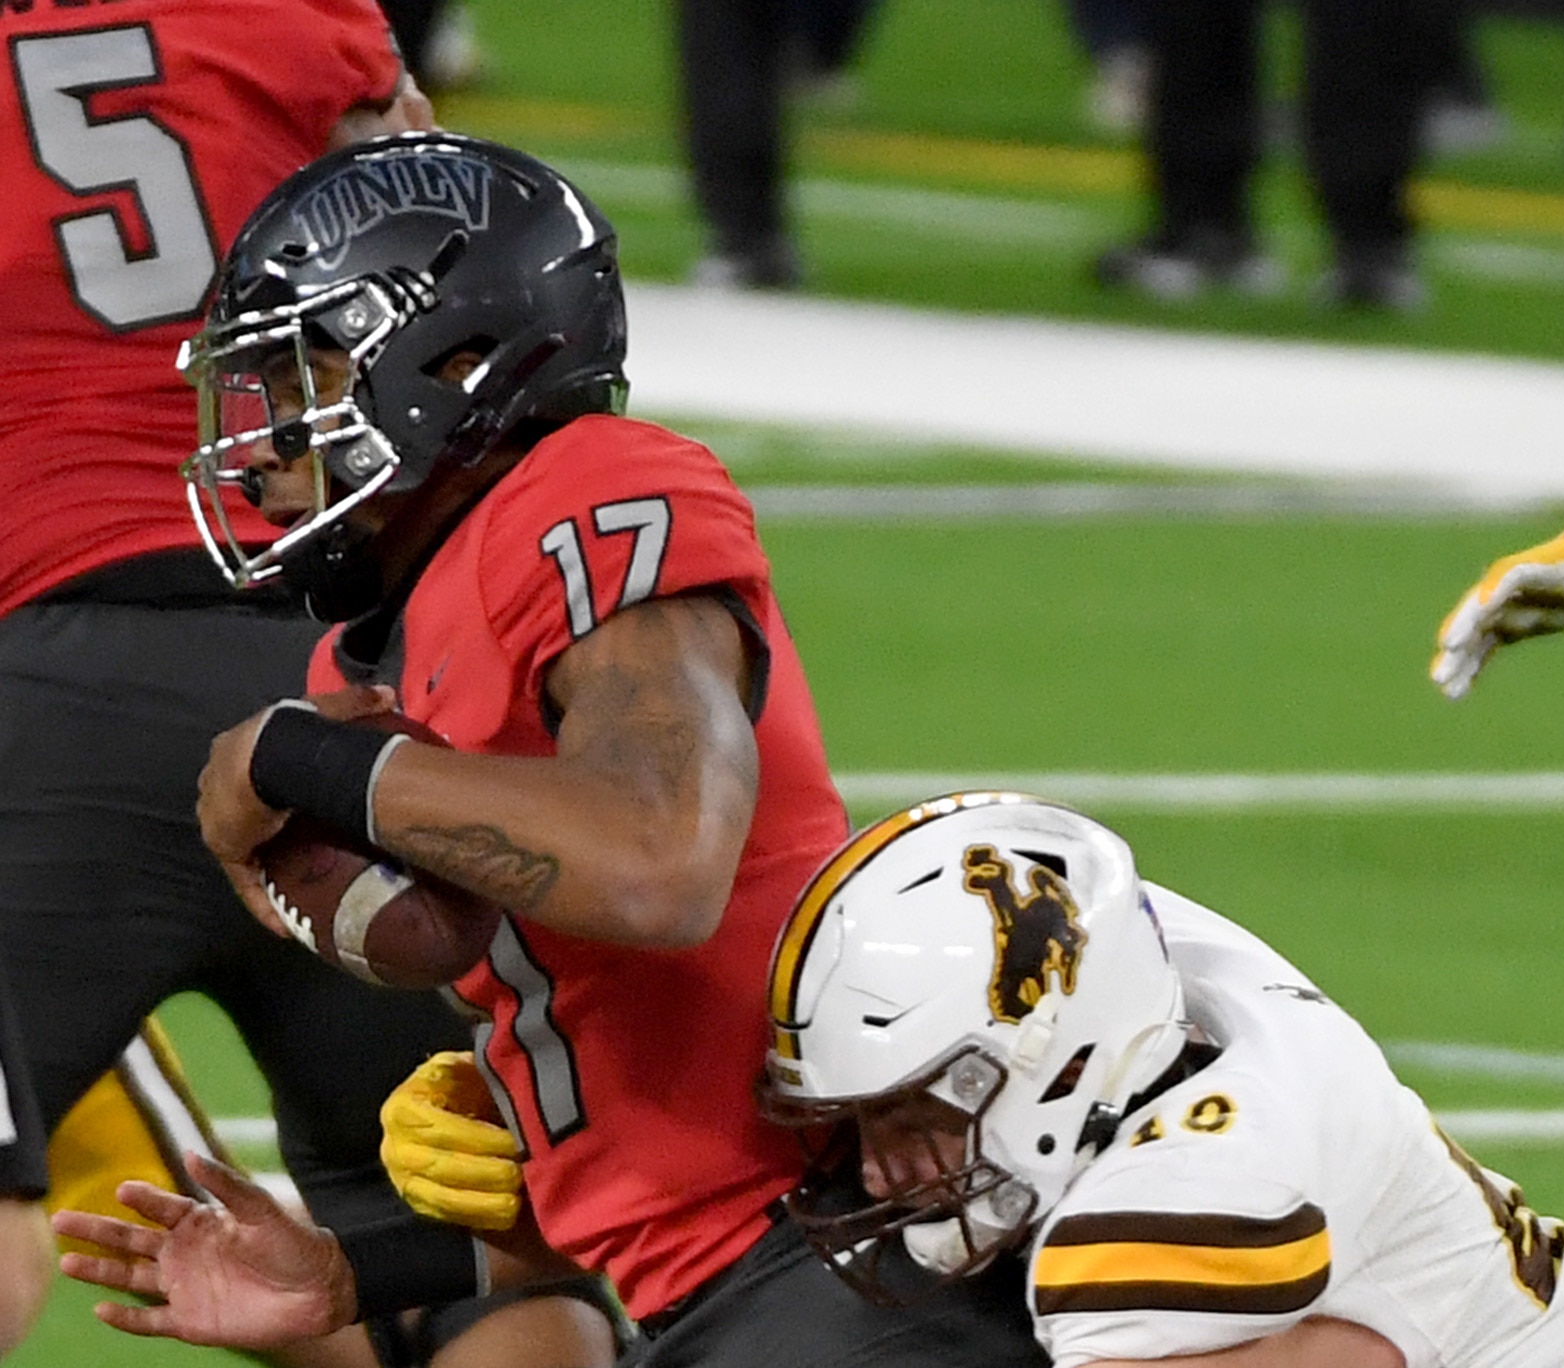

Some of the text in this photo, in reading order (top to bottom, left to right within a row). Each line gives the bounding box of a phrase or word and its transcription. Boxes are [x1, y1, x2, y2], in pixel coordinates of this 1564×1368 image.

[9, 22, 219, 334] 5
[290, 152, 494, 272] UNLV
[540, 495, 674, 645] 17
